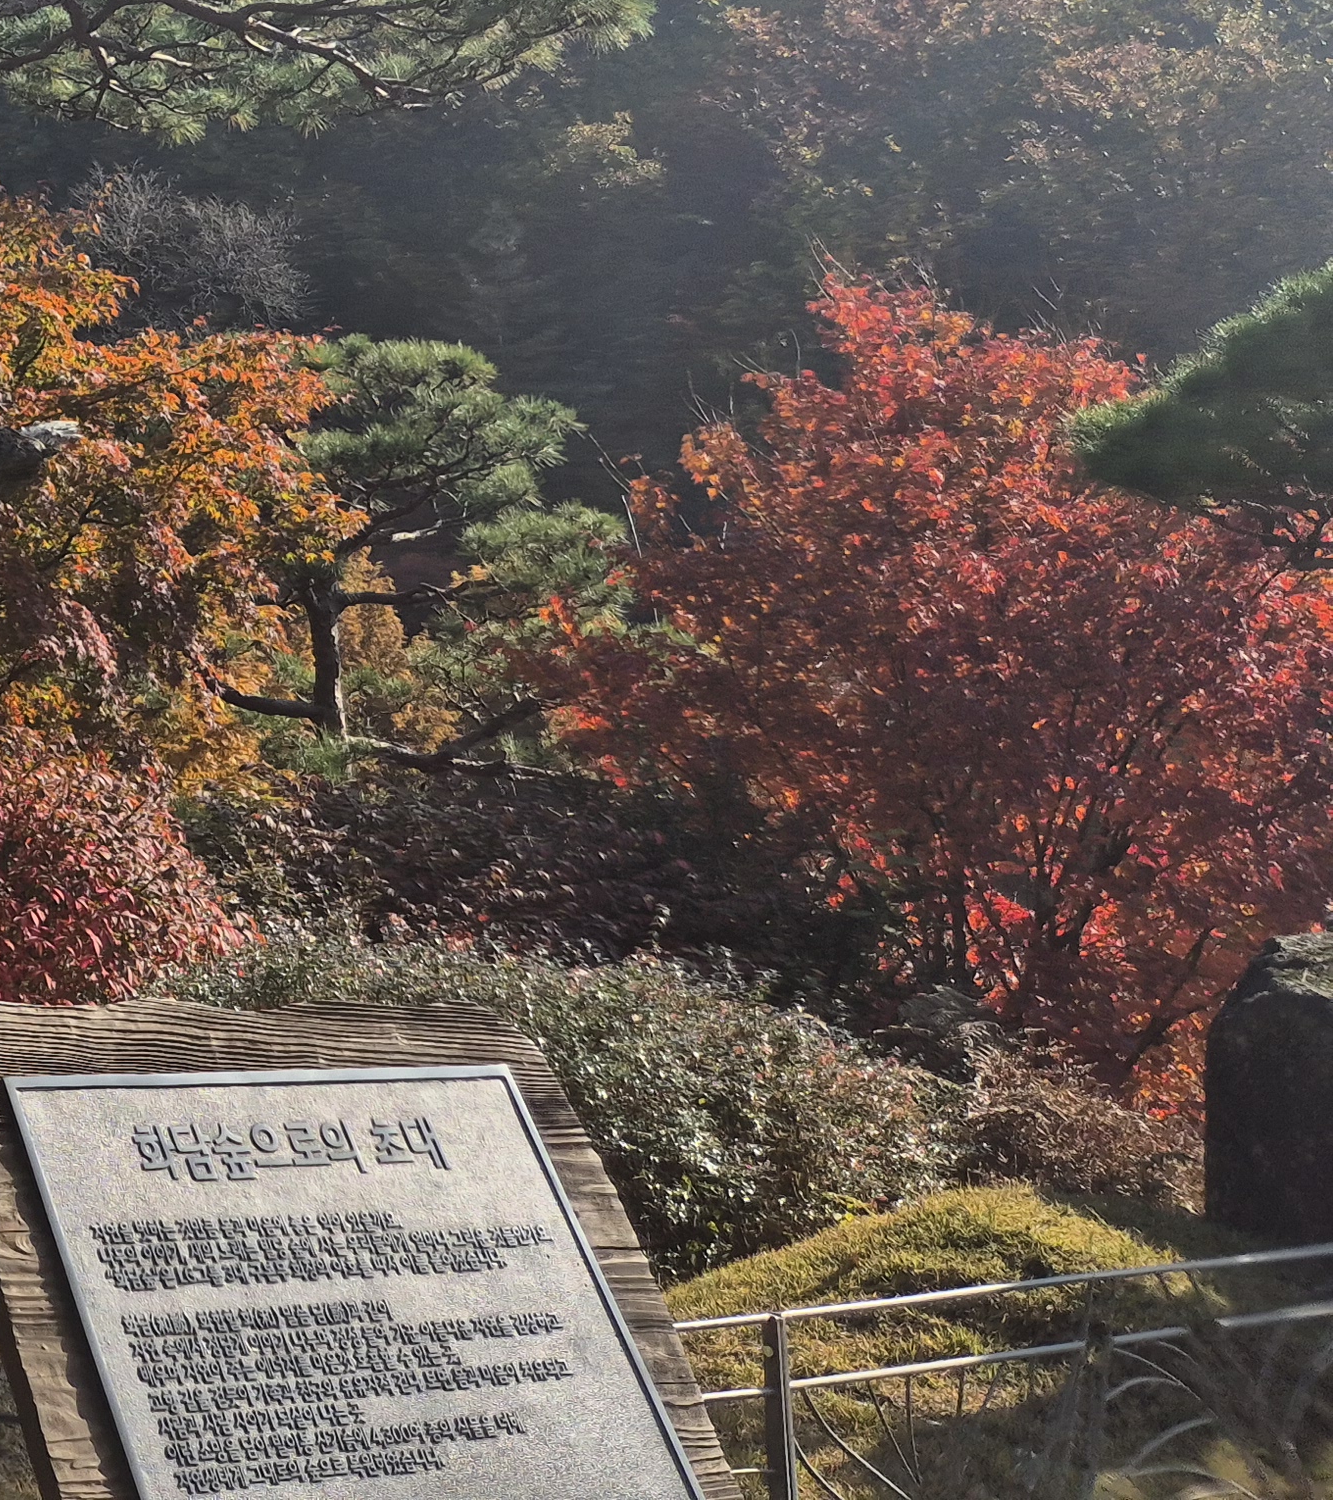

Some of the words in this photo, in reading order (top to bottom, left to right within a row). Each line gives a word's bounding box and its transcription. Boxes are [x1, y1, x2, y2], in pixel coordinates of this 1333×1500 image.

[132, 1118, 367, 1181] 화담숲으로의
[371, 1117, 451, 1170] 초대
[89, 1221, 134, 1245] 자연을
[175, 1218, 219, 1240] 것만큼
[218, 1216, 247, 1239] 몸과
[246, 1214, 289, 1237] 마음에
[288, 1214, 319, 1236] 좋은
[317, 1212, 346, 1235] 약이
[97, 1245, 141, 1269] 나무의
[188, 1242, 219, 1264] 새의
[216, 1238, 260, 1262] 노래는
[257, 1237, 287, 1260] 빌딩
[288, 1236, 317, 1259] 숲에
[318, 1236, 347, 1257] 사는
[346, 1232, 412, 1256] 우리들에게
[410, 1230, 450, 1252] 얼마나
[449, 1227, 490, 1249] 그리운
[221, 1262, 249, 1285] 3대
[248, 1260, 290, 1284] 구본무
[289, 1258, 332, 1282] 회장의
[331, 1256, 374, 1279] 아호를
[370, 1255, 402, 1276] 따서
[128, 1339, 163, 1363] 자연
[247, 1330, 292, 1355] 이야기
[288, 1328, 334, 1353] 나누며
[389, 1323, 420, 1345] 가꾼
[419, 1319, 475, 1342] 아름다운
[469, 1315, 515, 1338] 자연을
[508, 1312, 564, 1336] 감상하고
[196, 1308, 241, 1334] 화합할
[137, 1361, 184, 1388] 배우며
[180, 1359, 227, 1384] 자연이
[225, 1358, 258, 1382] 주는
[254, 1353, 312, 1379] 에너지를
[397, 1347, 411, 1369] 수
[411, 1345, 442, 1368] 있는
[148, 1390, 179, 1415] 고향
[251, 1380, 297, 1406] 가족과
[296, 1377, 339, 1403] 친구와
[340, 1374, 395, 1399] 유유자적
[451, 1365, 481, 1390] 몸과
[478, 1362, 521, 1387] 마음이
[519, 1357, 573, 1382] 치유되고
[157, 1415, 202, 1441] 사람과
[202, 1410, 234, 1436] 사람
[233, 1408, 276, 1434] 사이가
[163, 1440, 199, 1467] 이런
[198, 1437, 241, 1464] 소망을
[238, 1434, 271, 1461] 담아
[424, 1417, 455, 1444] 종의
[453, 1414, 498, 1441] 식물을
[493, 1410, 526, 1435] 더해
[173, 1465, 249, 1495] 자연생태계
[246, 1459, 305, 1485] 그대로의
[305, 1456, 349, 1483] 숲으로
